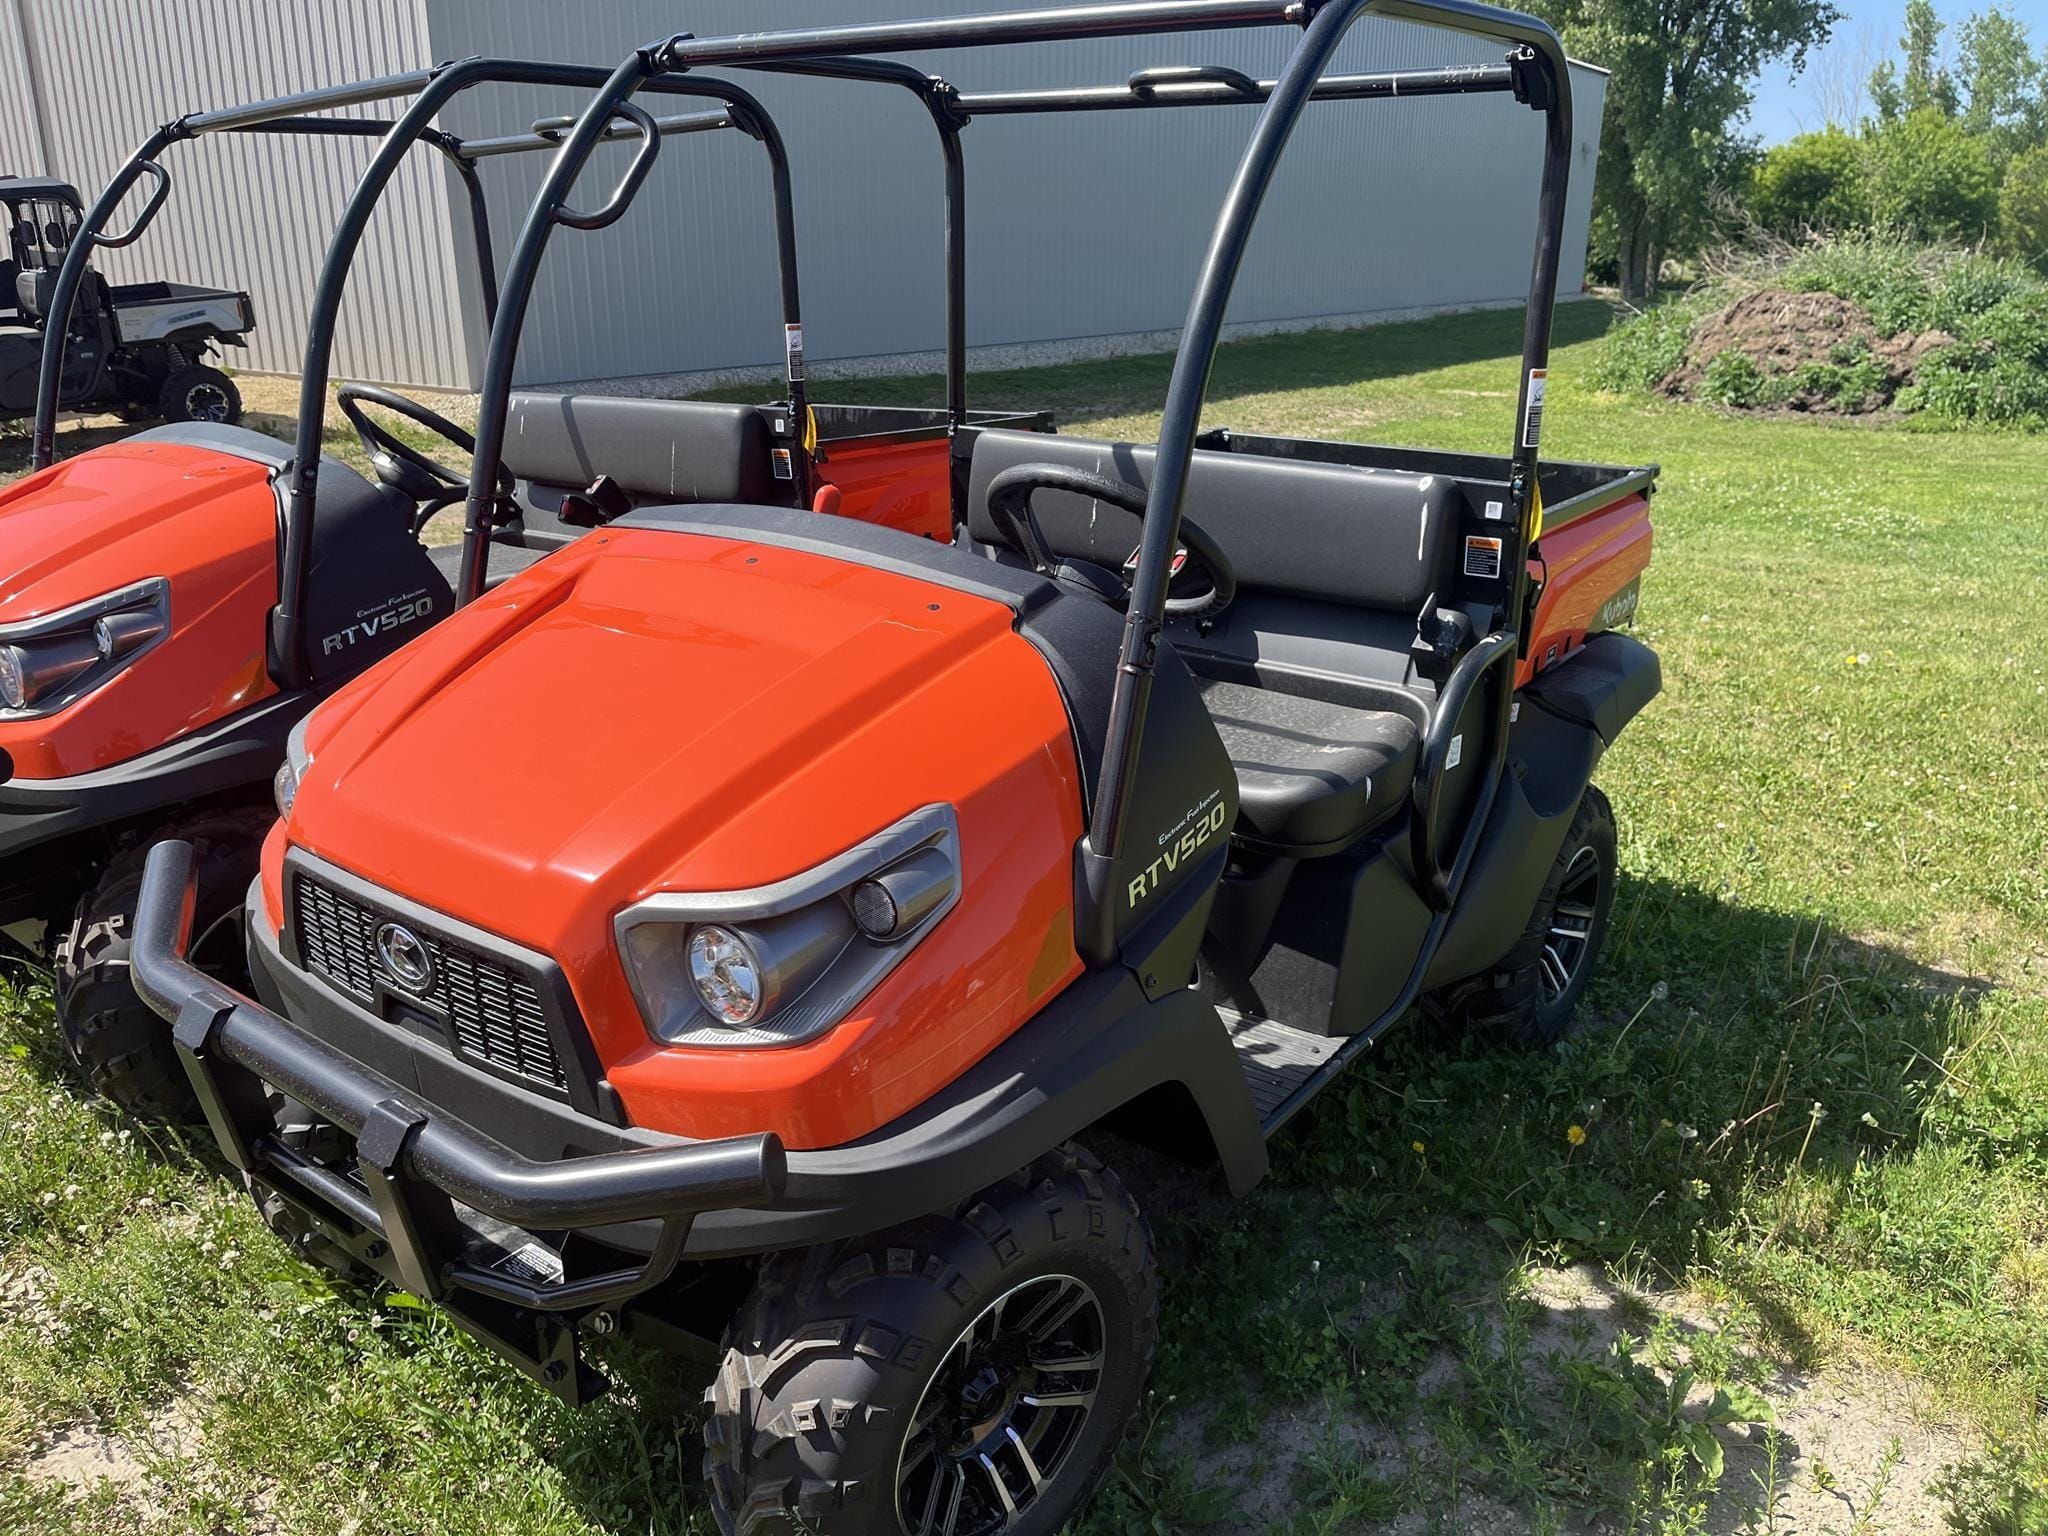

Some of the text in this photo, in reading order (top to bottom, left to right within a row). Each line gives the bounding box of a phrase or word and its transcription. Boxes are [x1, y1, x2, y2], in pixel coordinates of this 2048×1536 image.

[322, 596, 433, 656] RTV520
[1602, 589, 1636, 624] Kubota
[1128, 801, 1225, 908] RTV520
